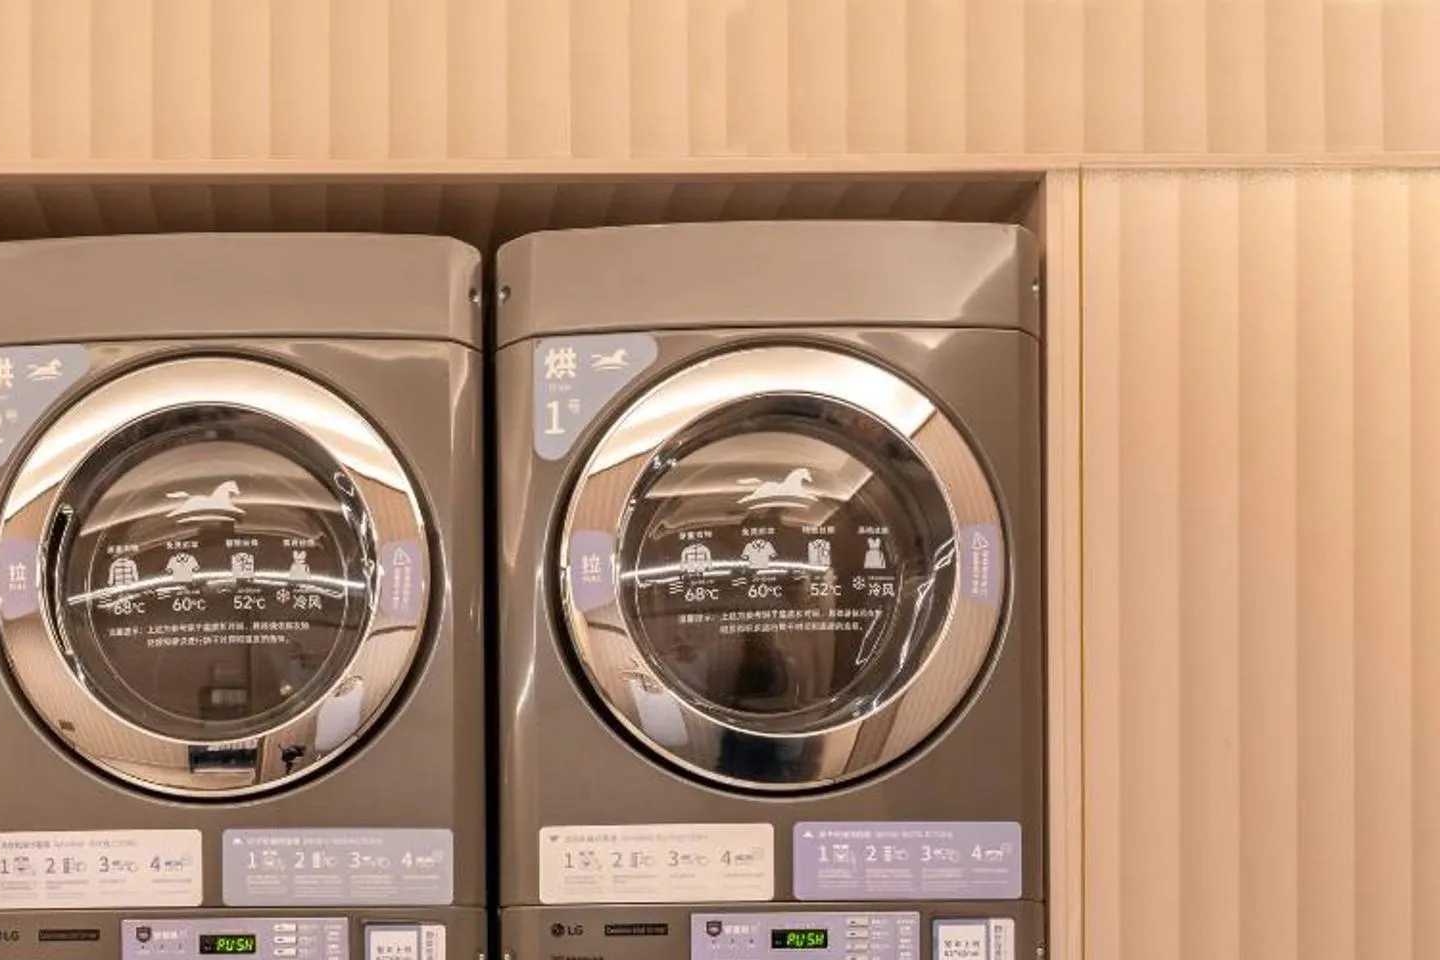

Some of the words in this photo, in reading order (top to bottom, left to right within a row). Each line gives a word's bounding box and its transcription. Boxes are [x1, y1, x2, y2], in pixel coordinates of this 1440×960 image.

[544, 346, 577, 380] 烘
[248, 852, 257, 868] 1
[294, 852, 306, 868] 2
[349, 852, 361, 868] 3
[401, 851, 413, 867] 4
[564, 852, 573, 868] 1
[611, 851, 622, 868] 2
[667, 850, 679, 867] 3
[720, 850, 731, 866] 4
[819, 846, 828, 862] 1
[866, 846, 877, 862] 2
[921, 846, 932, 862] 3
[971, 845, 982, 862] 4
[0, 858, 9, 874] 1
[45, 858, 57, 874] 2
[99, 856, 109, 873] 3
[150, 856, 161, 872] 4
[216, 939, 254, 951] PUSH
[786, 933, 825, 946] PUSH
